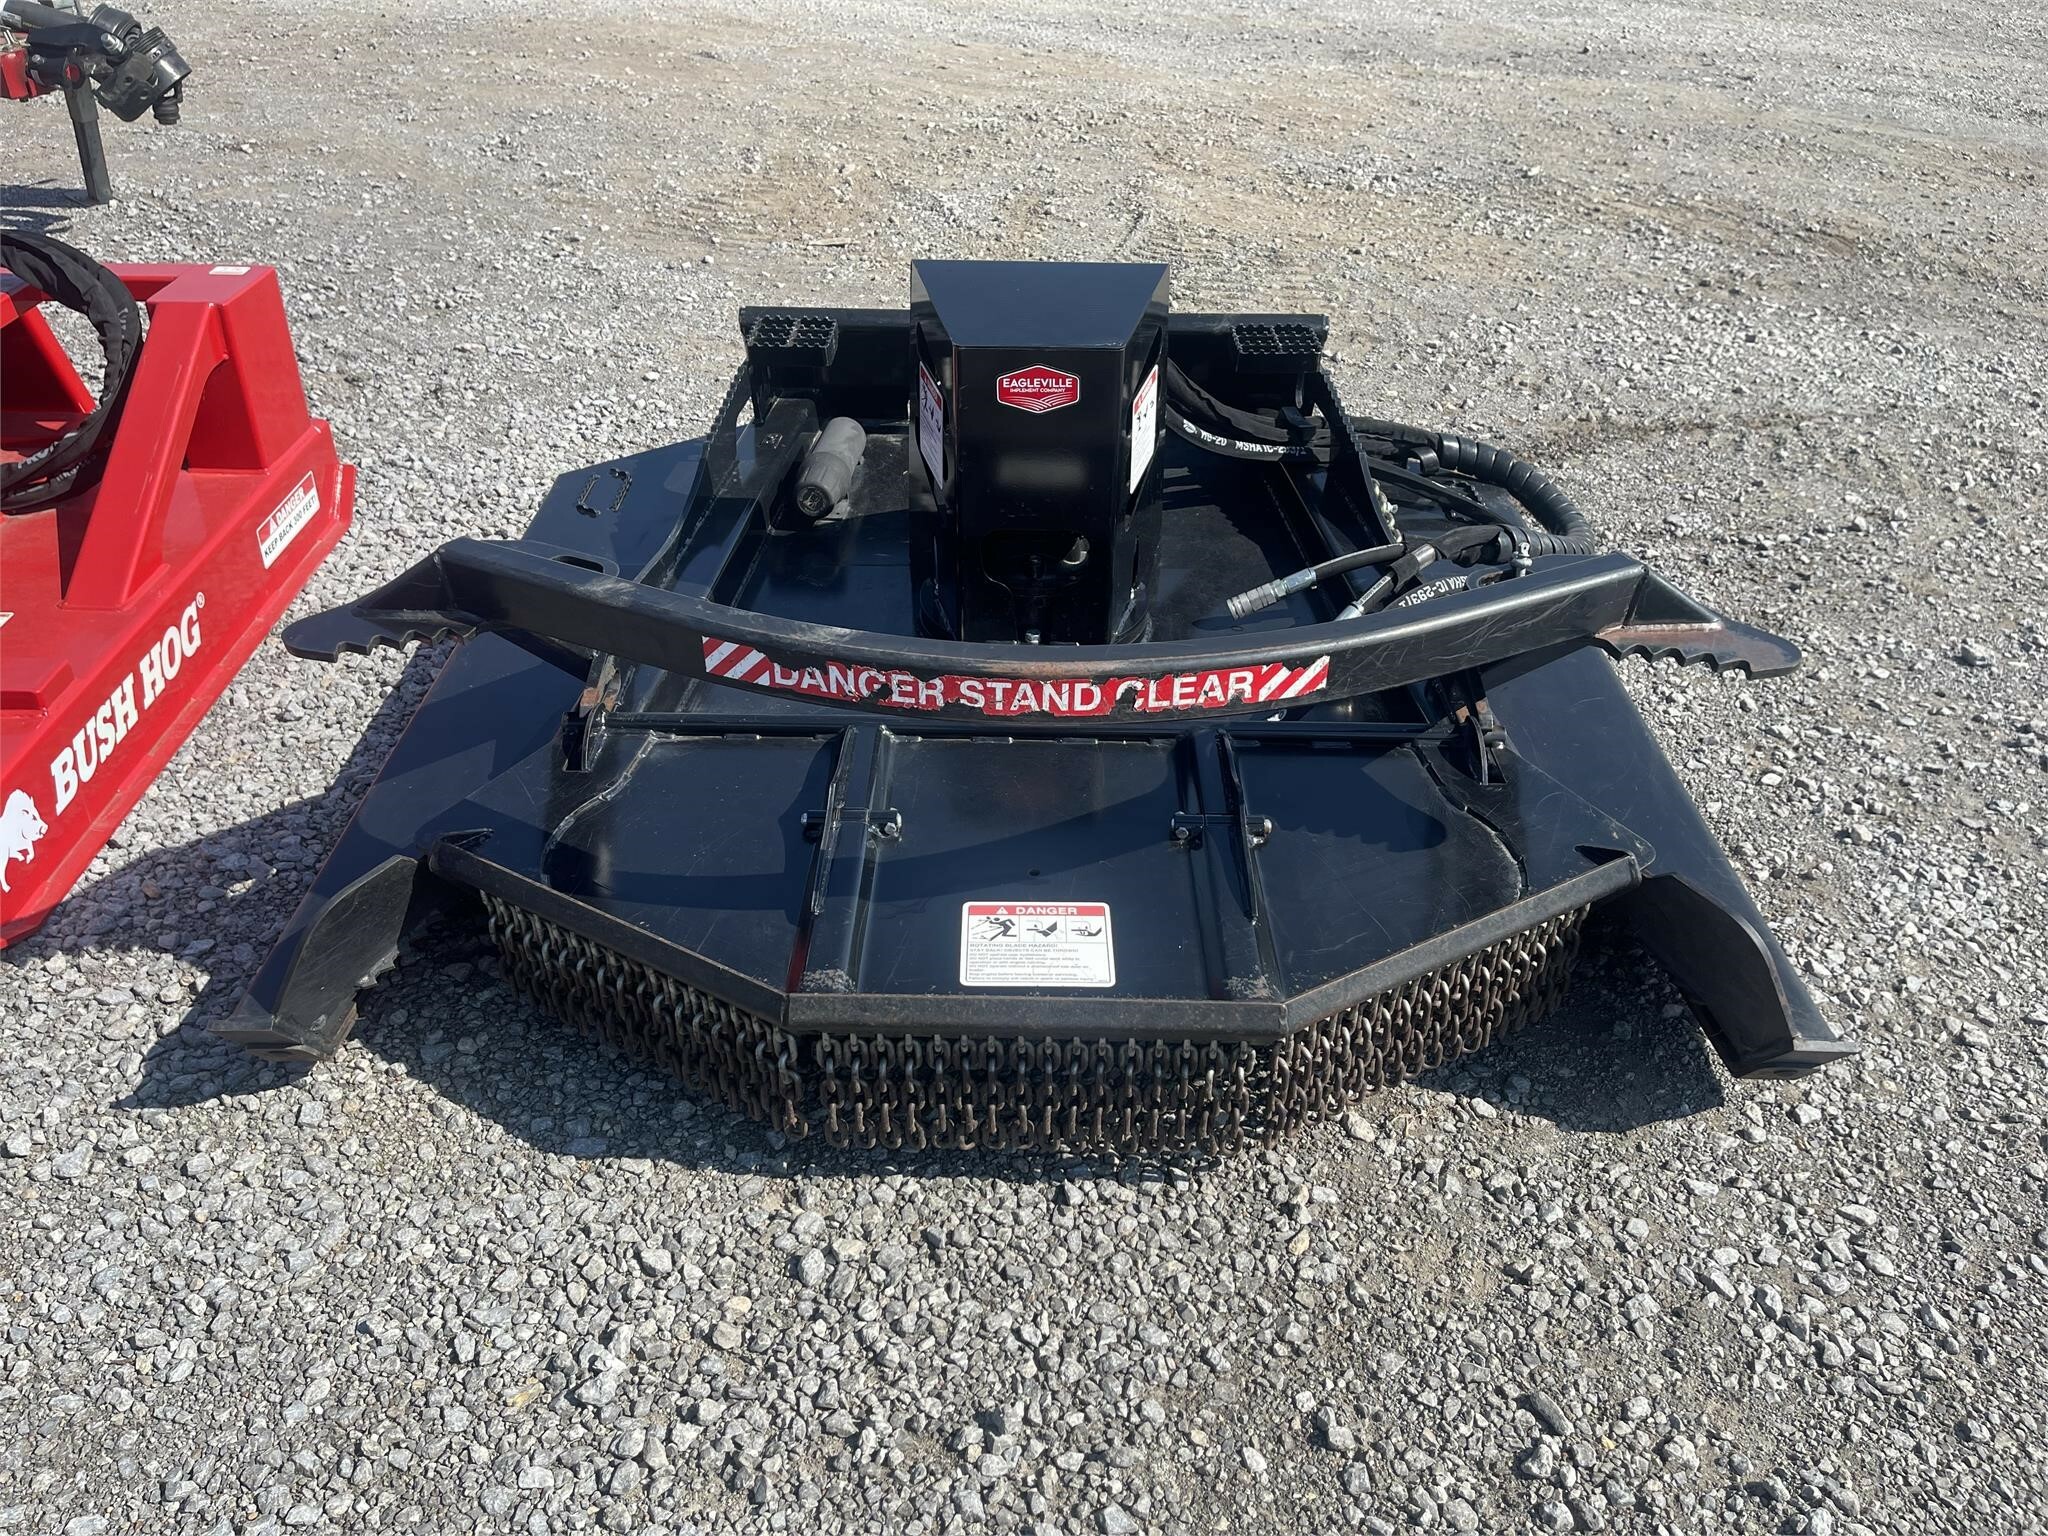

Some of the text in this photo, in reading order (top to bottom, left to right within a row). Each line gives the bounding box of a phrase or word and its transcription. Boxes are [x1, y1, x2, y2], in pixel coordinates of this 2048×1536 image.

[1003, 378, 1073, 388] EAGLEVILLE
[275, 486, 306, 527] DANGER
[264, 538, 278, 558] KEEP
[279, 521, 293, 543] BACK
[773, 662, 1254, 712] DANGER STAND CLEAR
[50, 672, 139, 816] BUSH
[1015, 906, 1078, 915] DANGER
